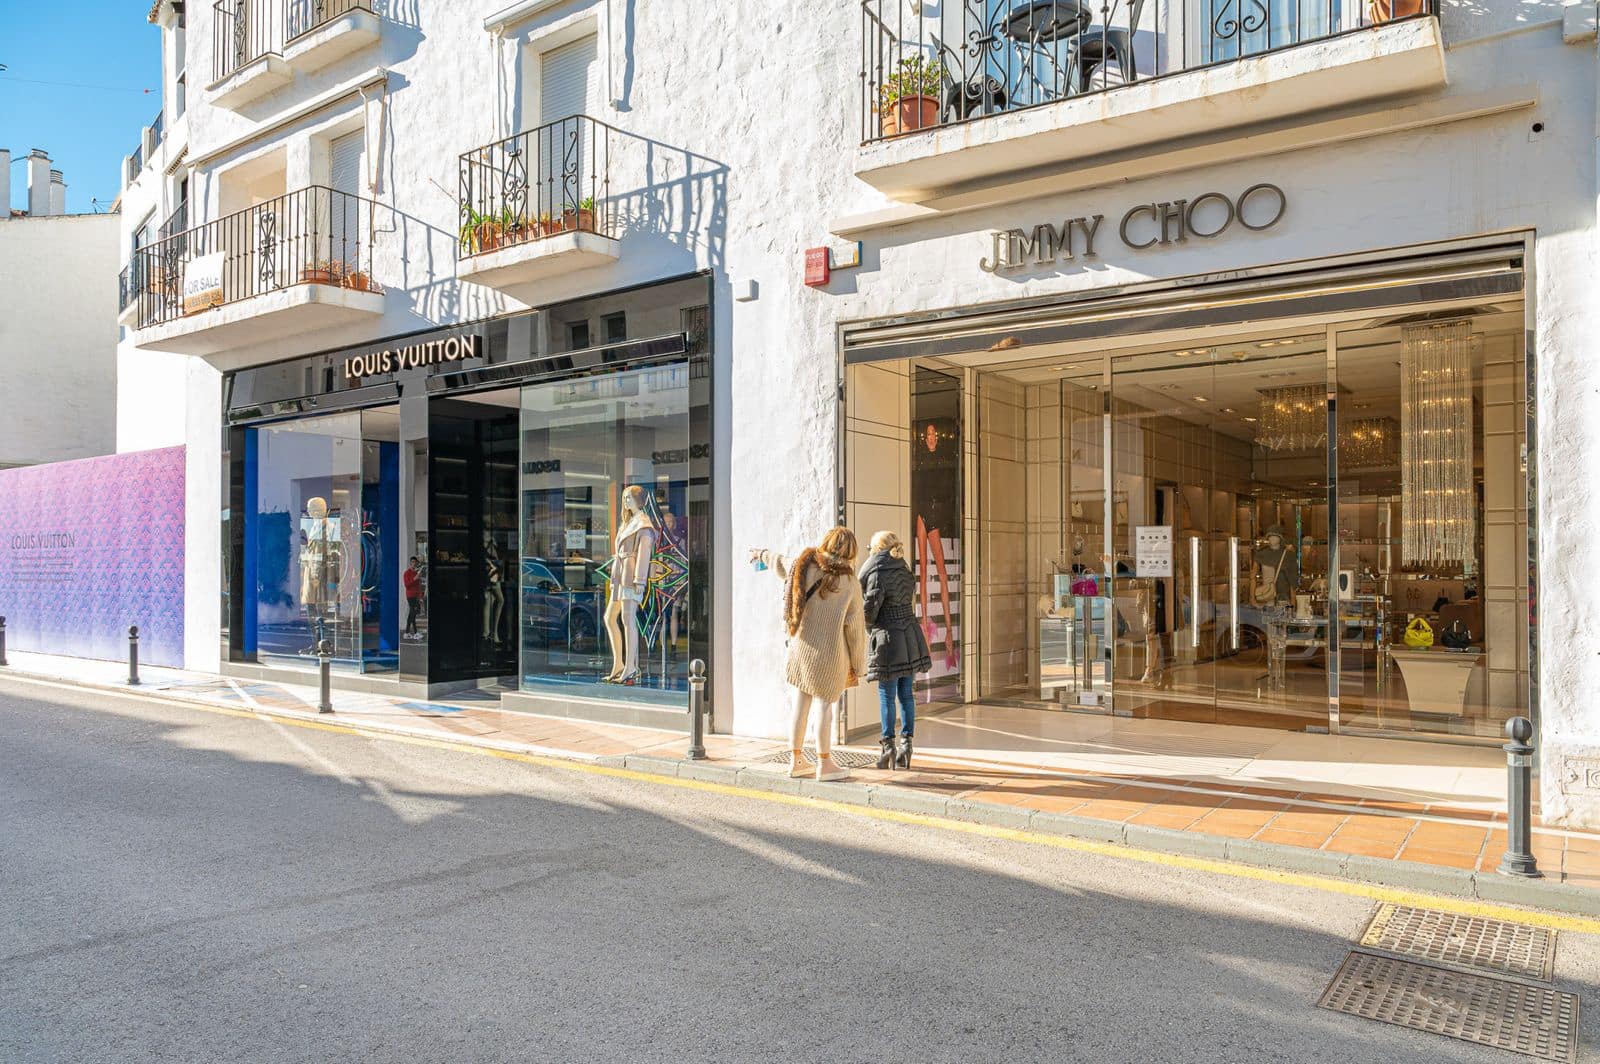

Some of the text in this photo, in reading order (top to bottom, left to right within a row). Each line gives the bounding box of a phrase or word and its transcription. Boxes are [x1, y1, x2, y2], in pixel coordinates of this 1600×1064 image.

[979, 183, 1287, 273] JIMMY CHOO
[200, 276, 220, 290] SALE
[345, 334, 475, 379] LOUIS VUITTON
[12, 531, 75, 550] LOUIS VUITTON
